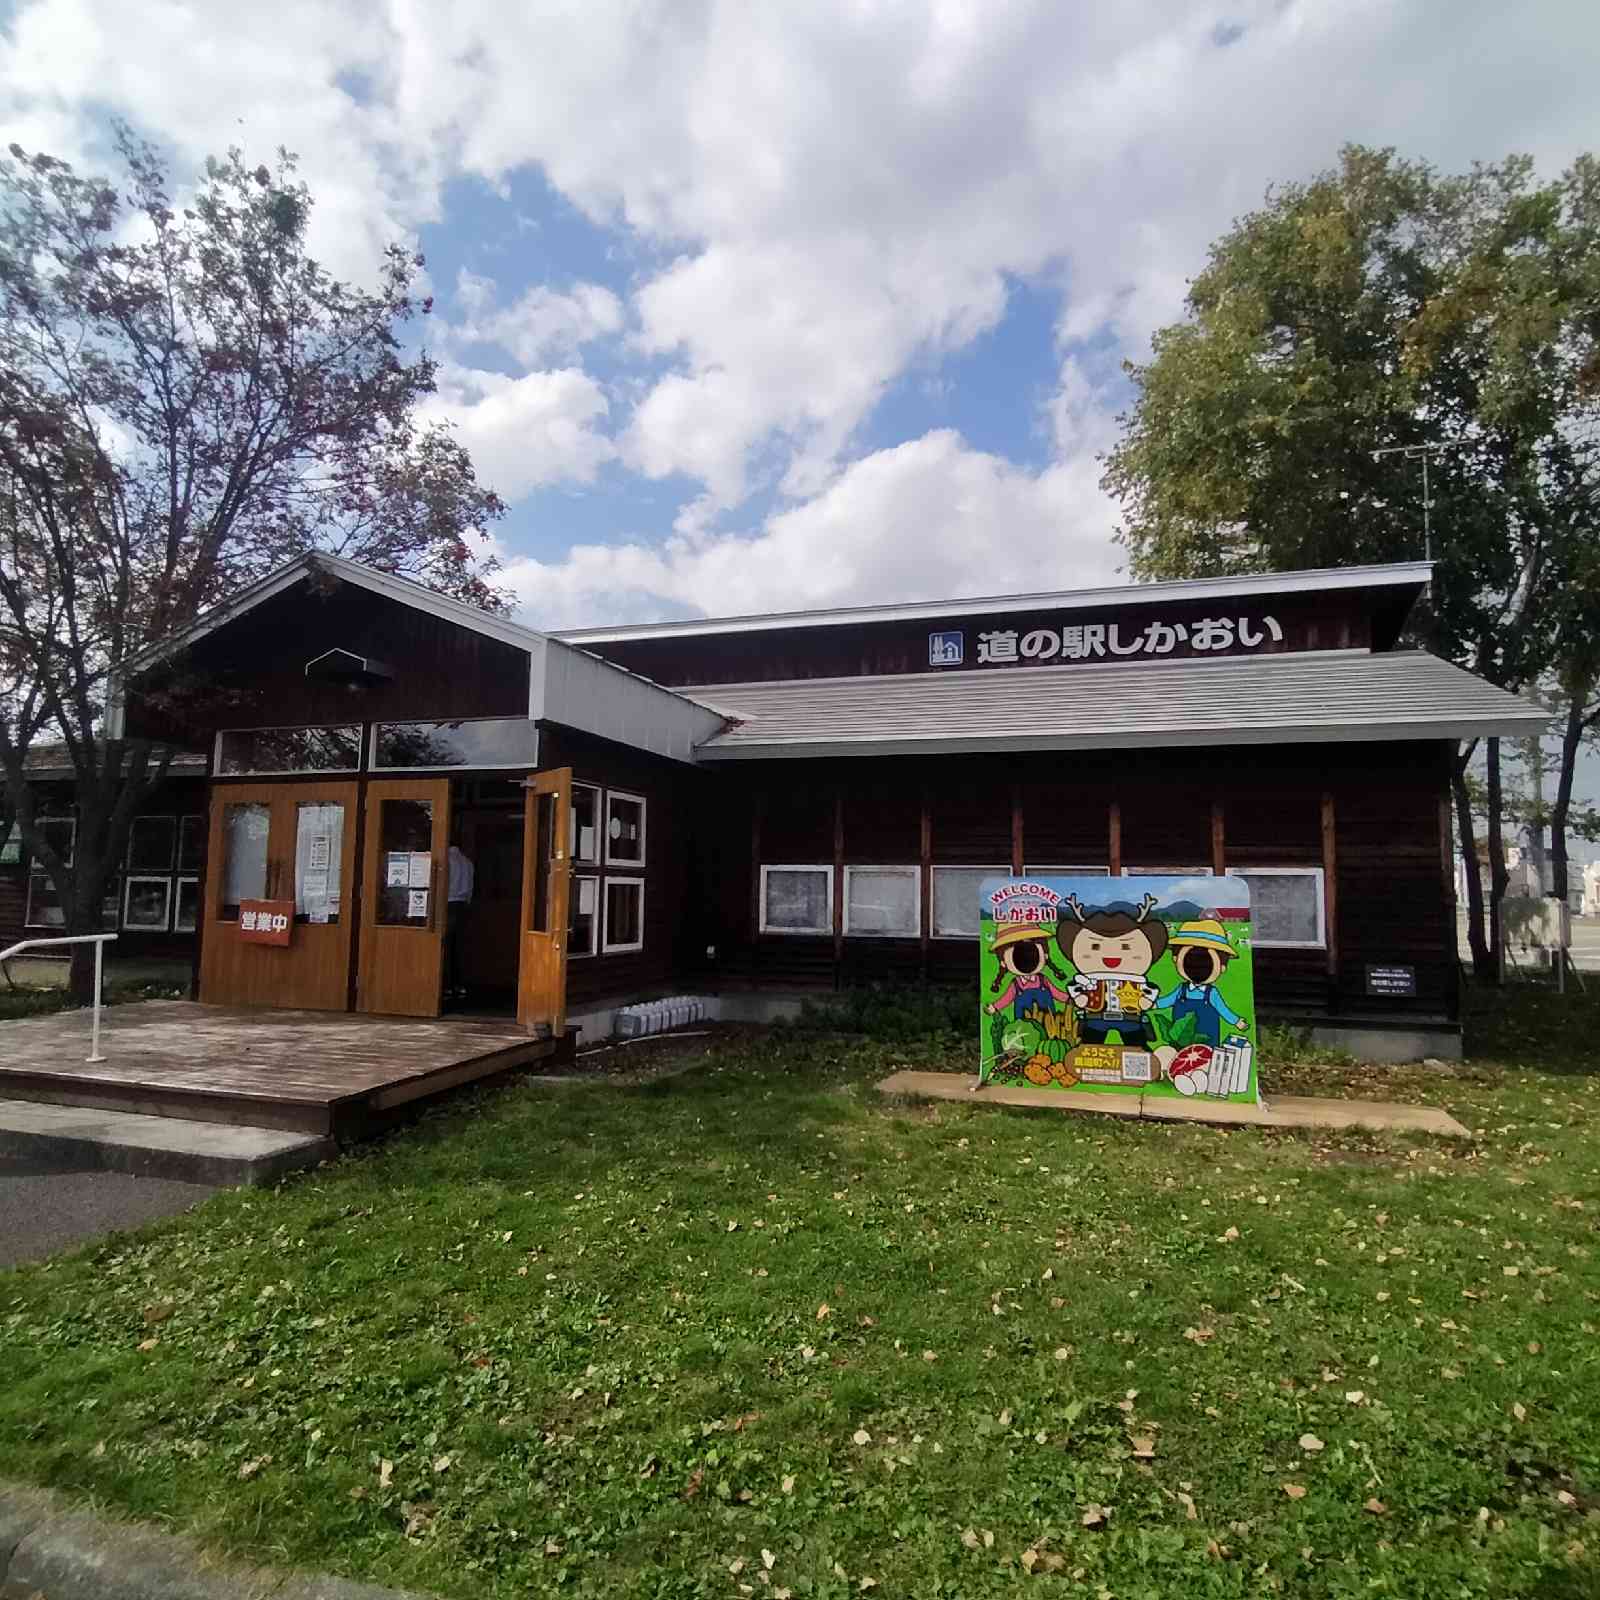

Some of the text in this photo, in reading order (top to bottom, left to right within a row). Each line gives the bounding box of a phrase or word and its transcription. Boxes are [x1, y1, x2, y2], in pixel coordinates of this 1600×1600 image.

[977, 616, 1283, 664] 道の駅しかおい
[991, 883, 1060, 905] WELCOME
[241, 911, 288, 932] 営業中
[994, 907, 1057, 921] しかおい
[1081, 1047, 1116, 1057] ようこそ
